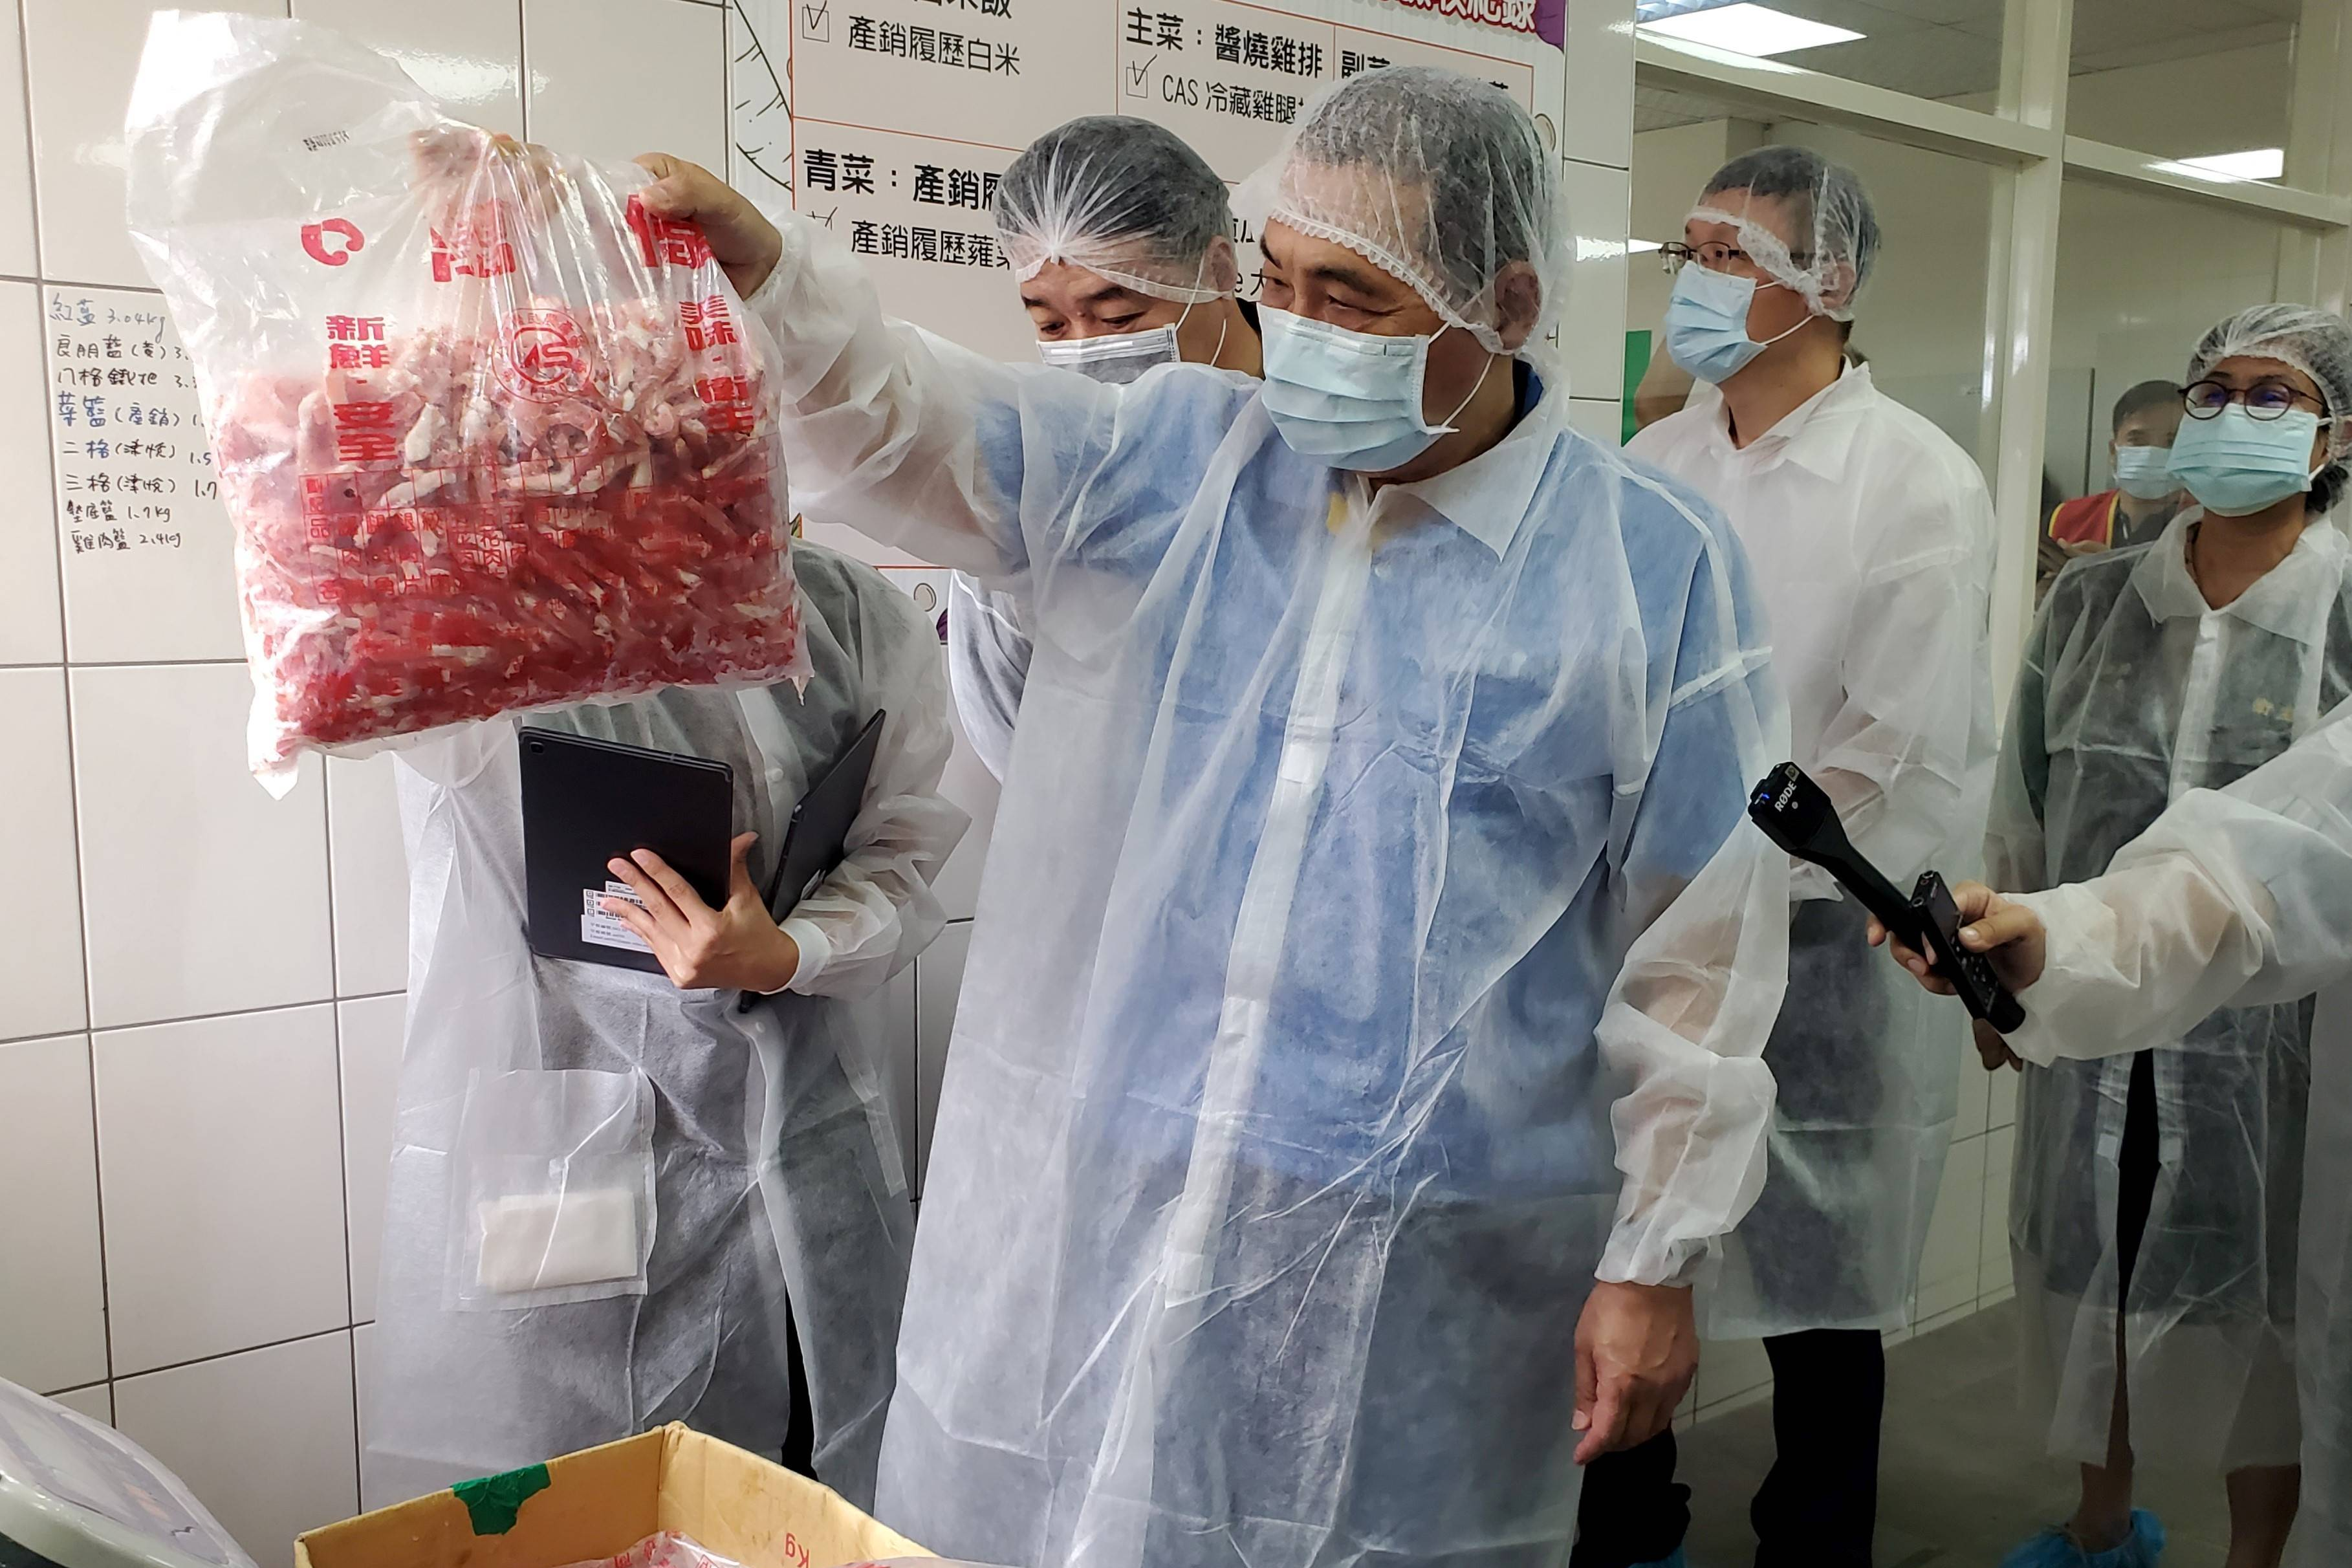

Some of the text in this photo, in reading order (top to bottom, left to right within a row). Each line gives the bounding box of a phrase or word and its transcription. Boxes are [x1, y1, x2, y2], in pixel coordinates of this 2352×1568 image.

[848, 15, 1020, 76] 產銷履歷白米
[1162, 74, 1303, 124] CAS 冷藏雞腿
